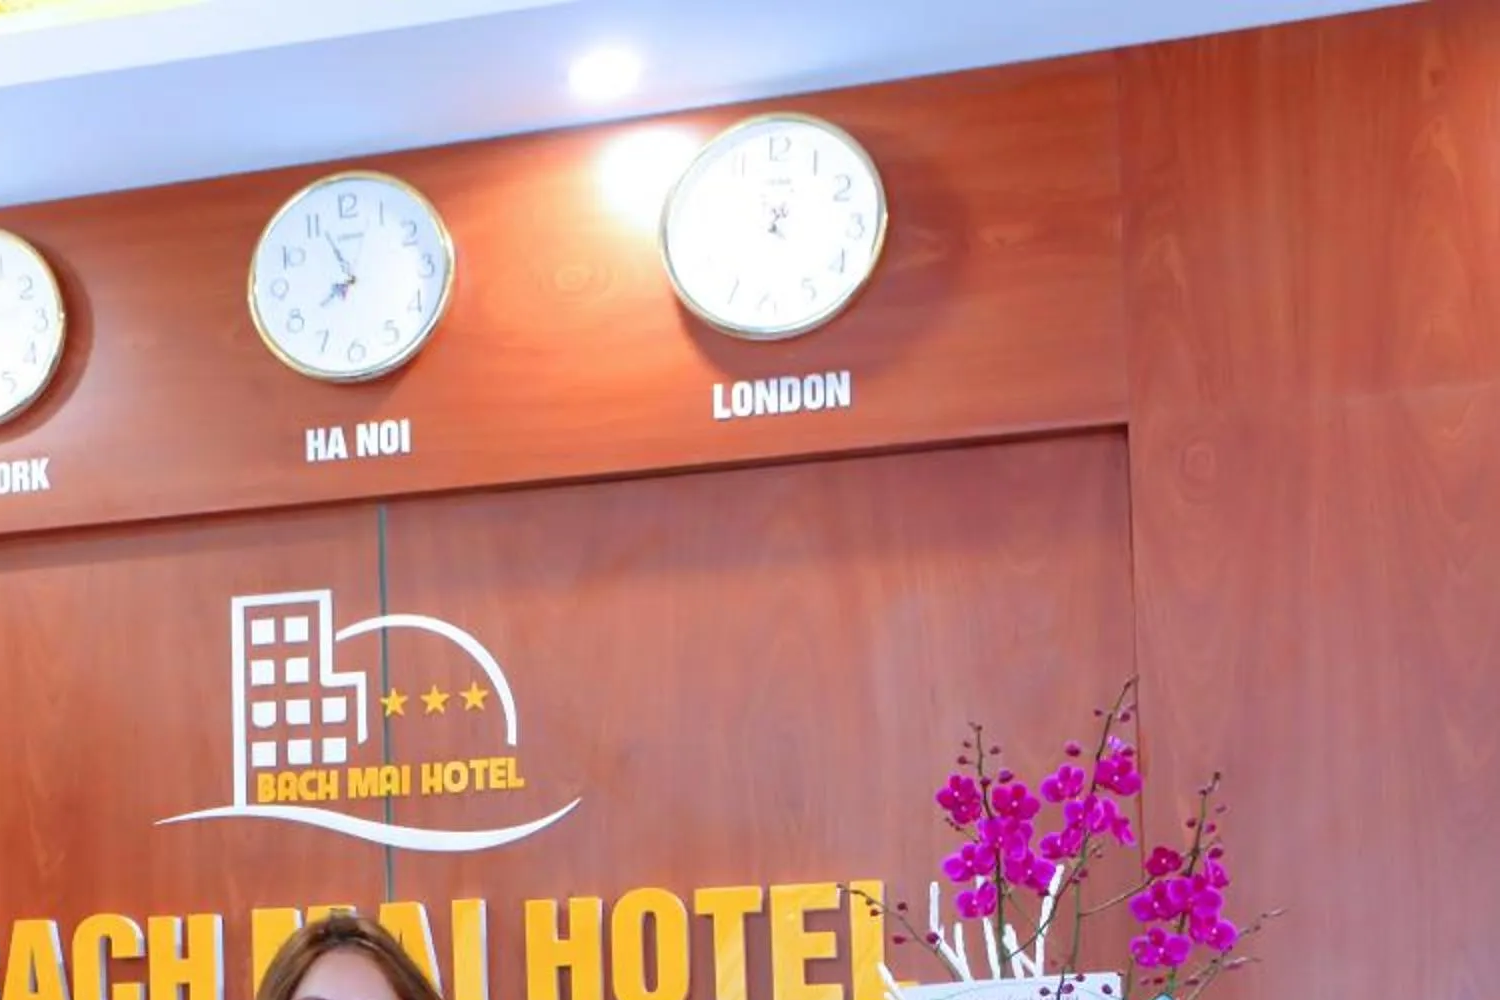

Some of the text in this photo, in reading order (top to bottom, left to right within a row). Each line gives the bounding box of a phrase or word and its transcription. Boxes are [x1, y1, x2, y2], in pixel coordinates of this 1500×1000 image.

[832, 174, 852, 202] 2
[337, 193, 358, 219] 12
[305, 213, 320, 239] 11
[400, 220, 419, 247] 2
[282, 245, 307, 270] 10
[418, 250, 436, 279] 3
[16, 274, 35, 301] 2
[405, 288, 423, 313] 4
[34, 306, 50, 334] 3
[285, 308, 306, 334] 8
[382, 319, 400, 346] 5
[314, 328, 331, 353] 7
[346, 337, 367, 364] 6
[712, 370, 851, 419] LONDON
[305, 418, 411, 462] HA NOI
[257, 757, 525, 803] BACH MAI HOTEL
